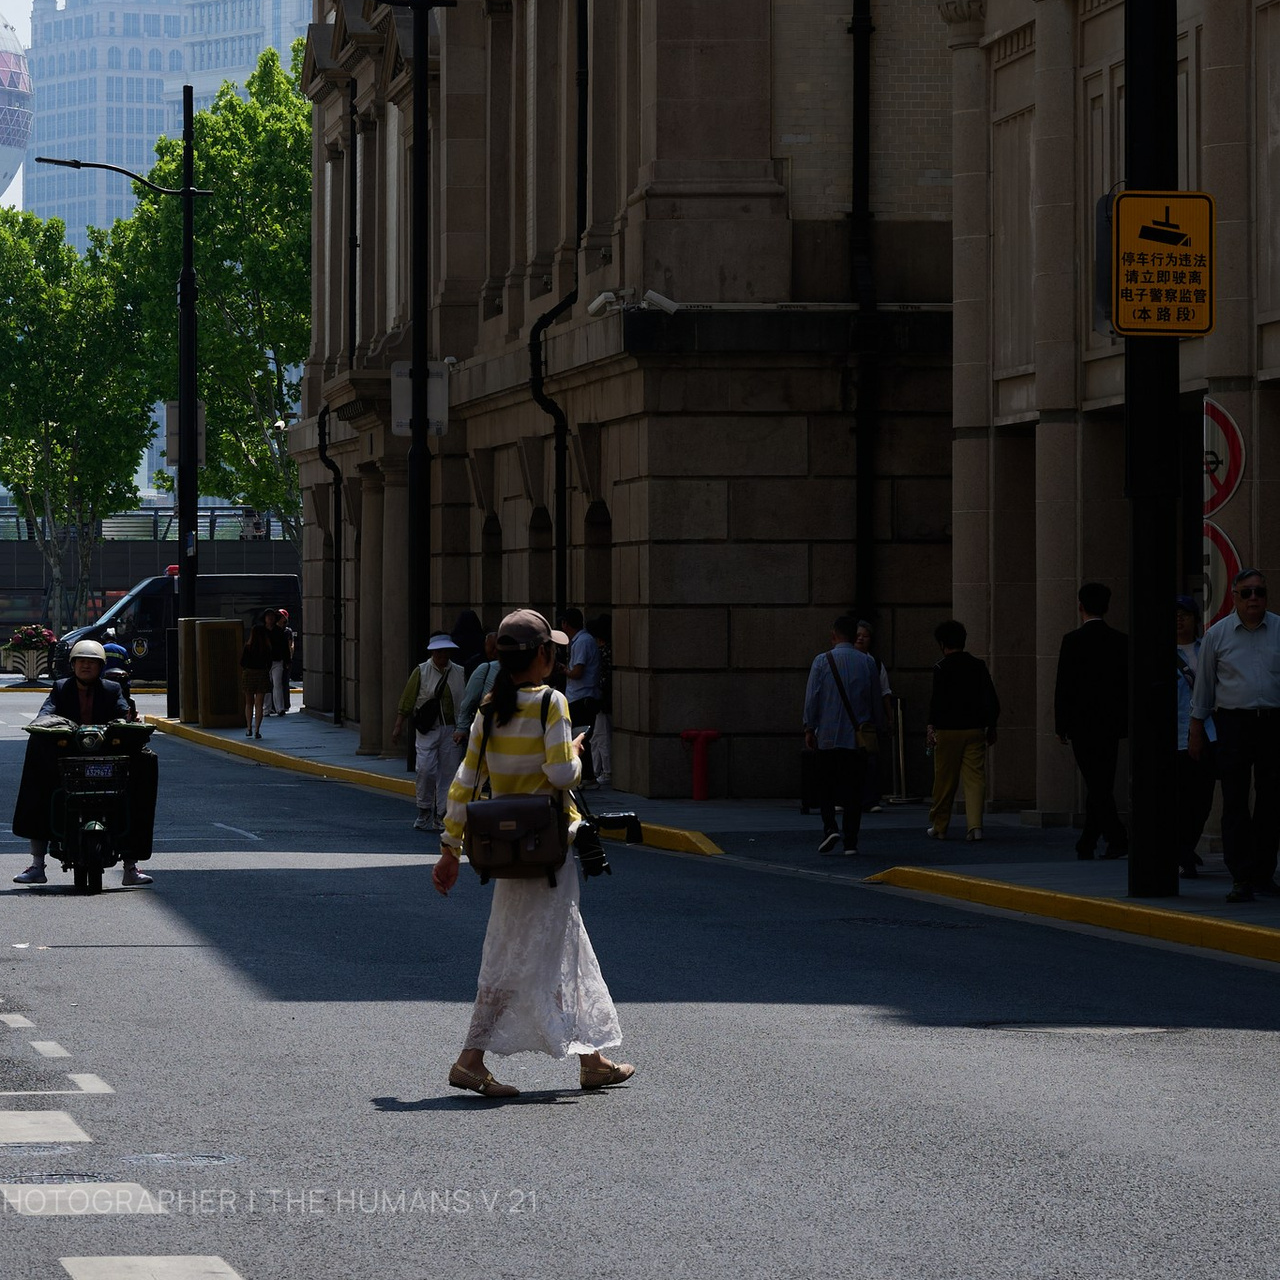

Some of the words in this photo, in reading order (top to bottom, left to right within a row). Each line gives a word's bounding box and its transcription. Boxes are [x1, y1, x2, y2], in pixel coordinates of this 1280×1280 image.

[1121, 252, 1207, 268] 停车行为违法
[1125, 270, 1202, 284] 请立即驶离
[1120, 287, 1207, 303] 电子警察监管
